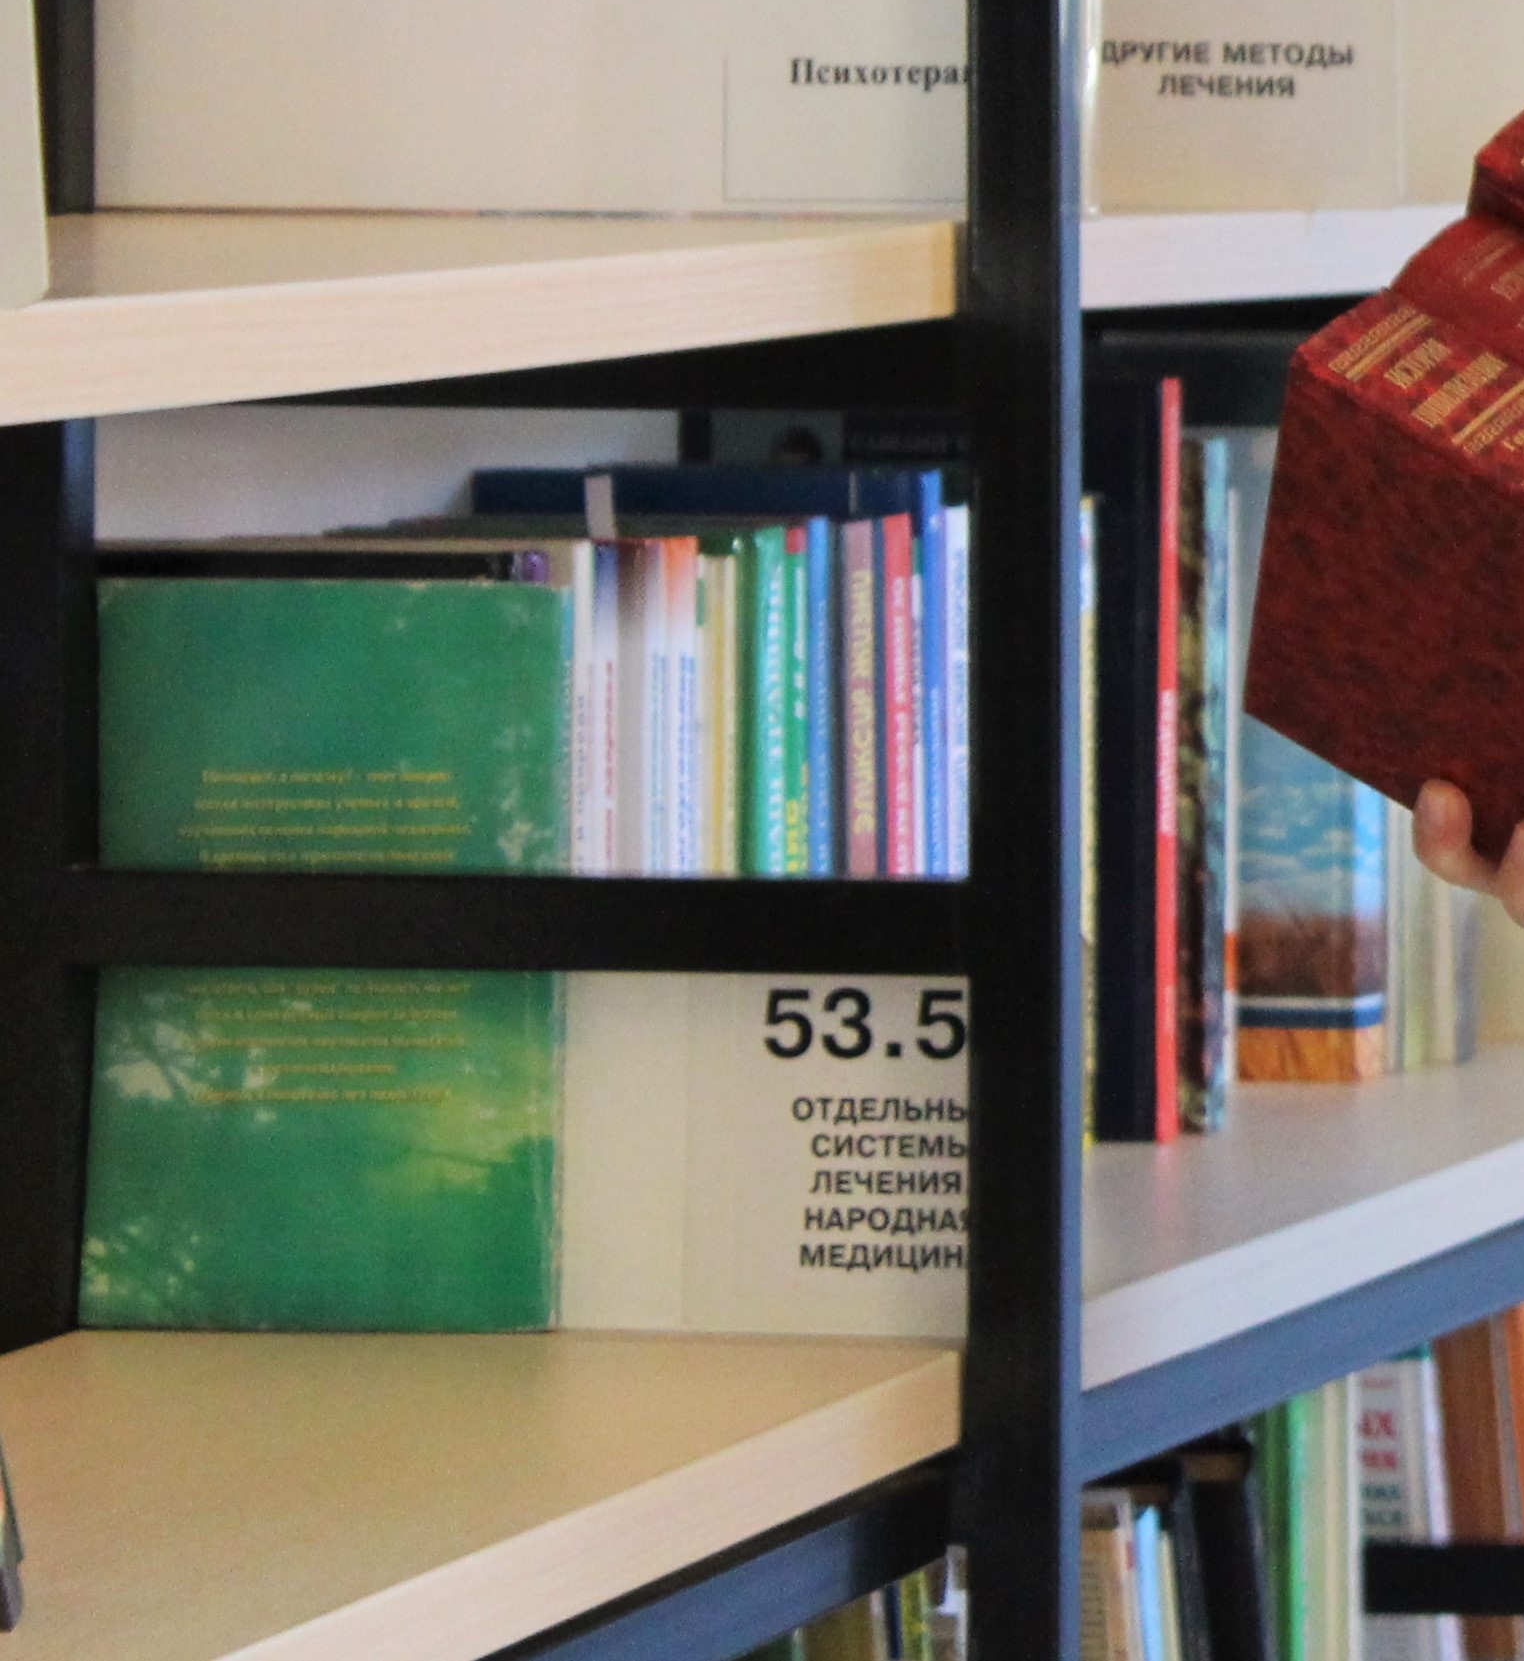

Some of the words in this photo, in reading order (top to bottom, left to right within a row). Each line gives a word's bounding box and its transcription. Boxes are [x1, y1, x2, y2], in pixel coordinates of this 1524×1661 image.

[1101, 40, 1211, 68] ДРУГИЕ
[1222, 41, 1355, 69] МЕТОДЫ
[790, 56, 968, 93] Психотера
[1157, 74, 1296, 98] ЛЕЧЕНИЯ
